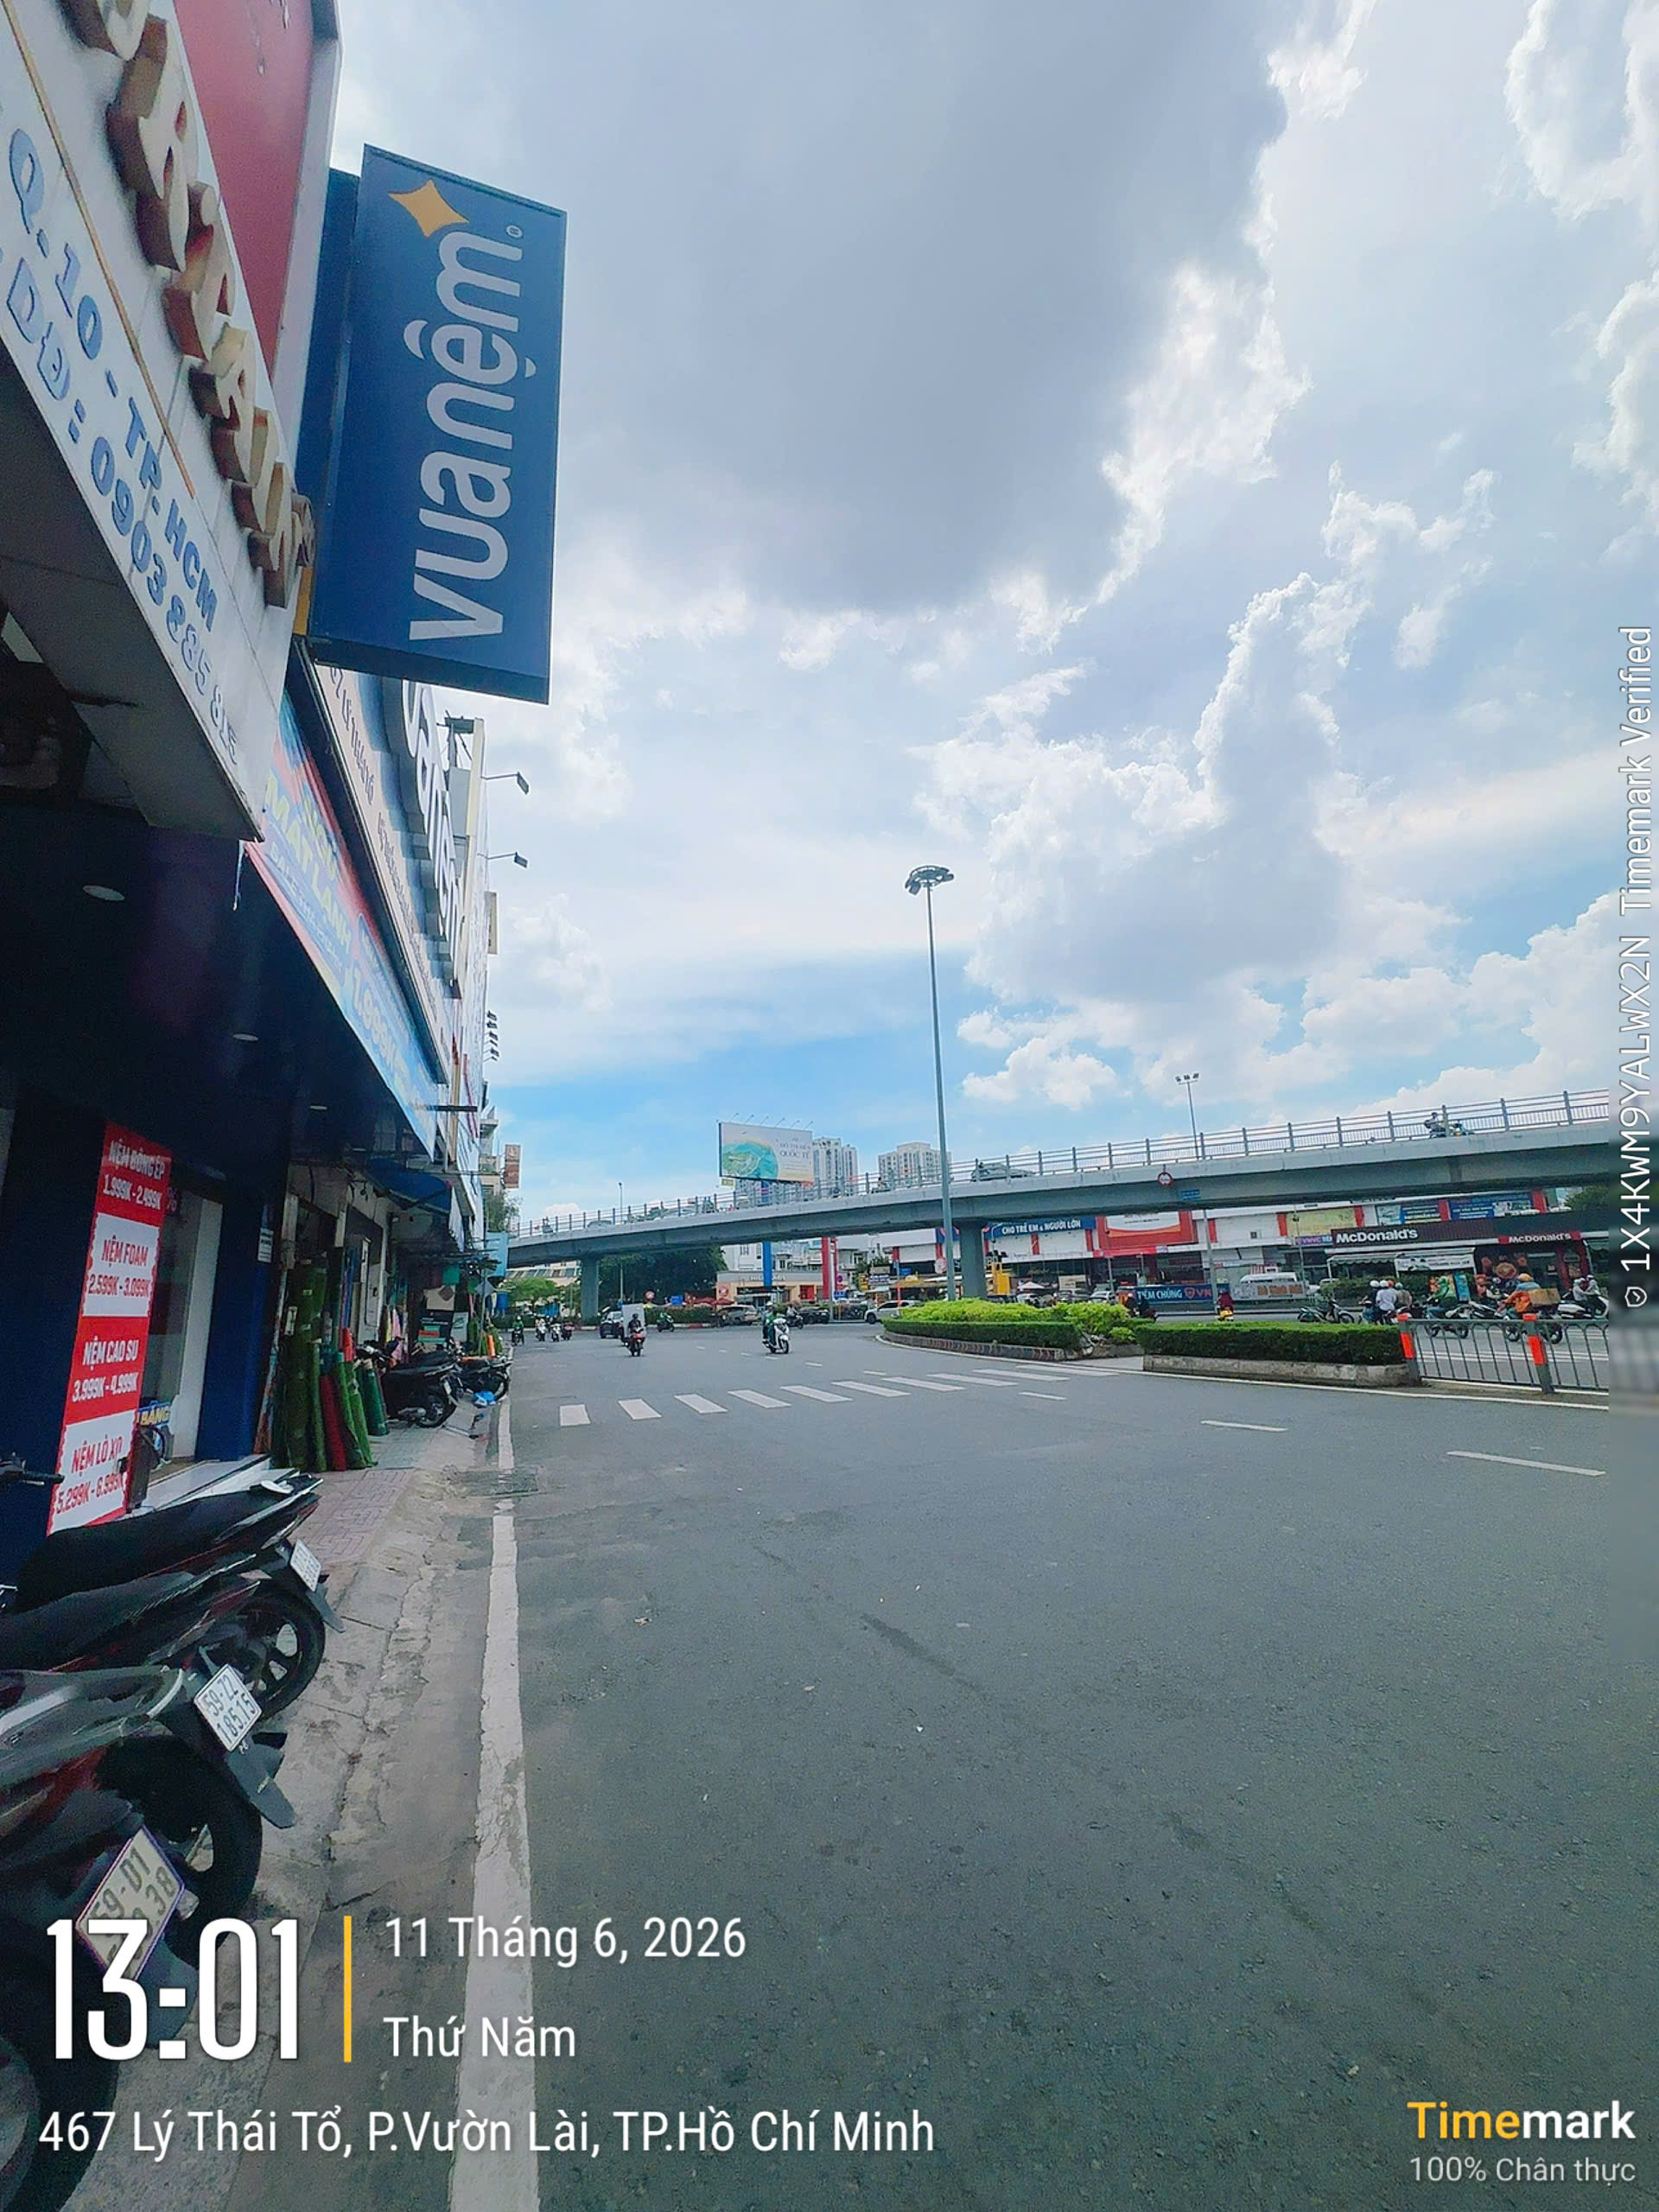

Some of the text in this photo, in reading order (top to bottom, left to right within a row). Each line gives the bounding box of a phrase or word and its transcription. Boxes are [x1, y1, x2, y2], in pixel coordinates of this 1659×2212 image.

[404, 230, 537, 641] vuanệm
[101, 1235, 149, 1268] NỆM FOAM
[1336, 1229, 1418, 1244] McDonald's
[1508, 1232, 1571, 1244] McDonald's
[83, 1336, 139, 1371] NỆM CAO SU
[71, 1440, 95, 1477] NỆM
[95, 1434, 110, 1465] LÒ
